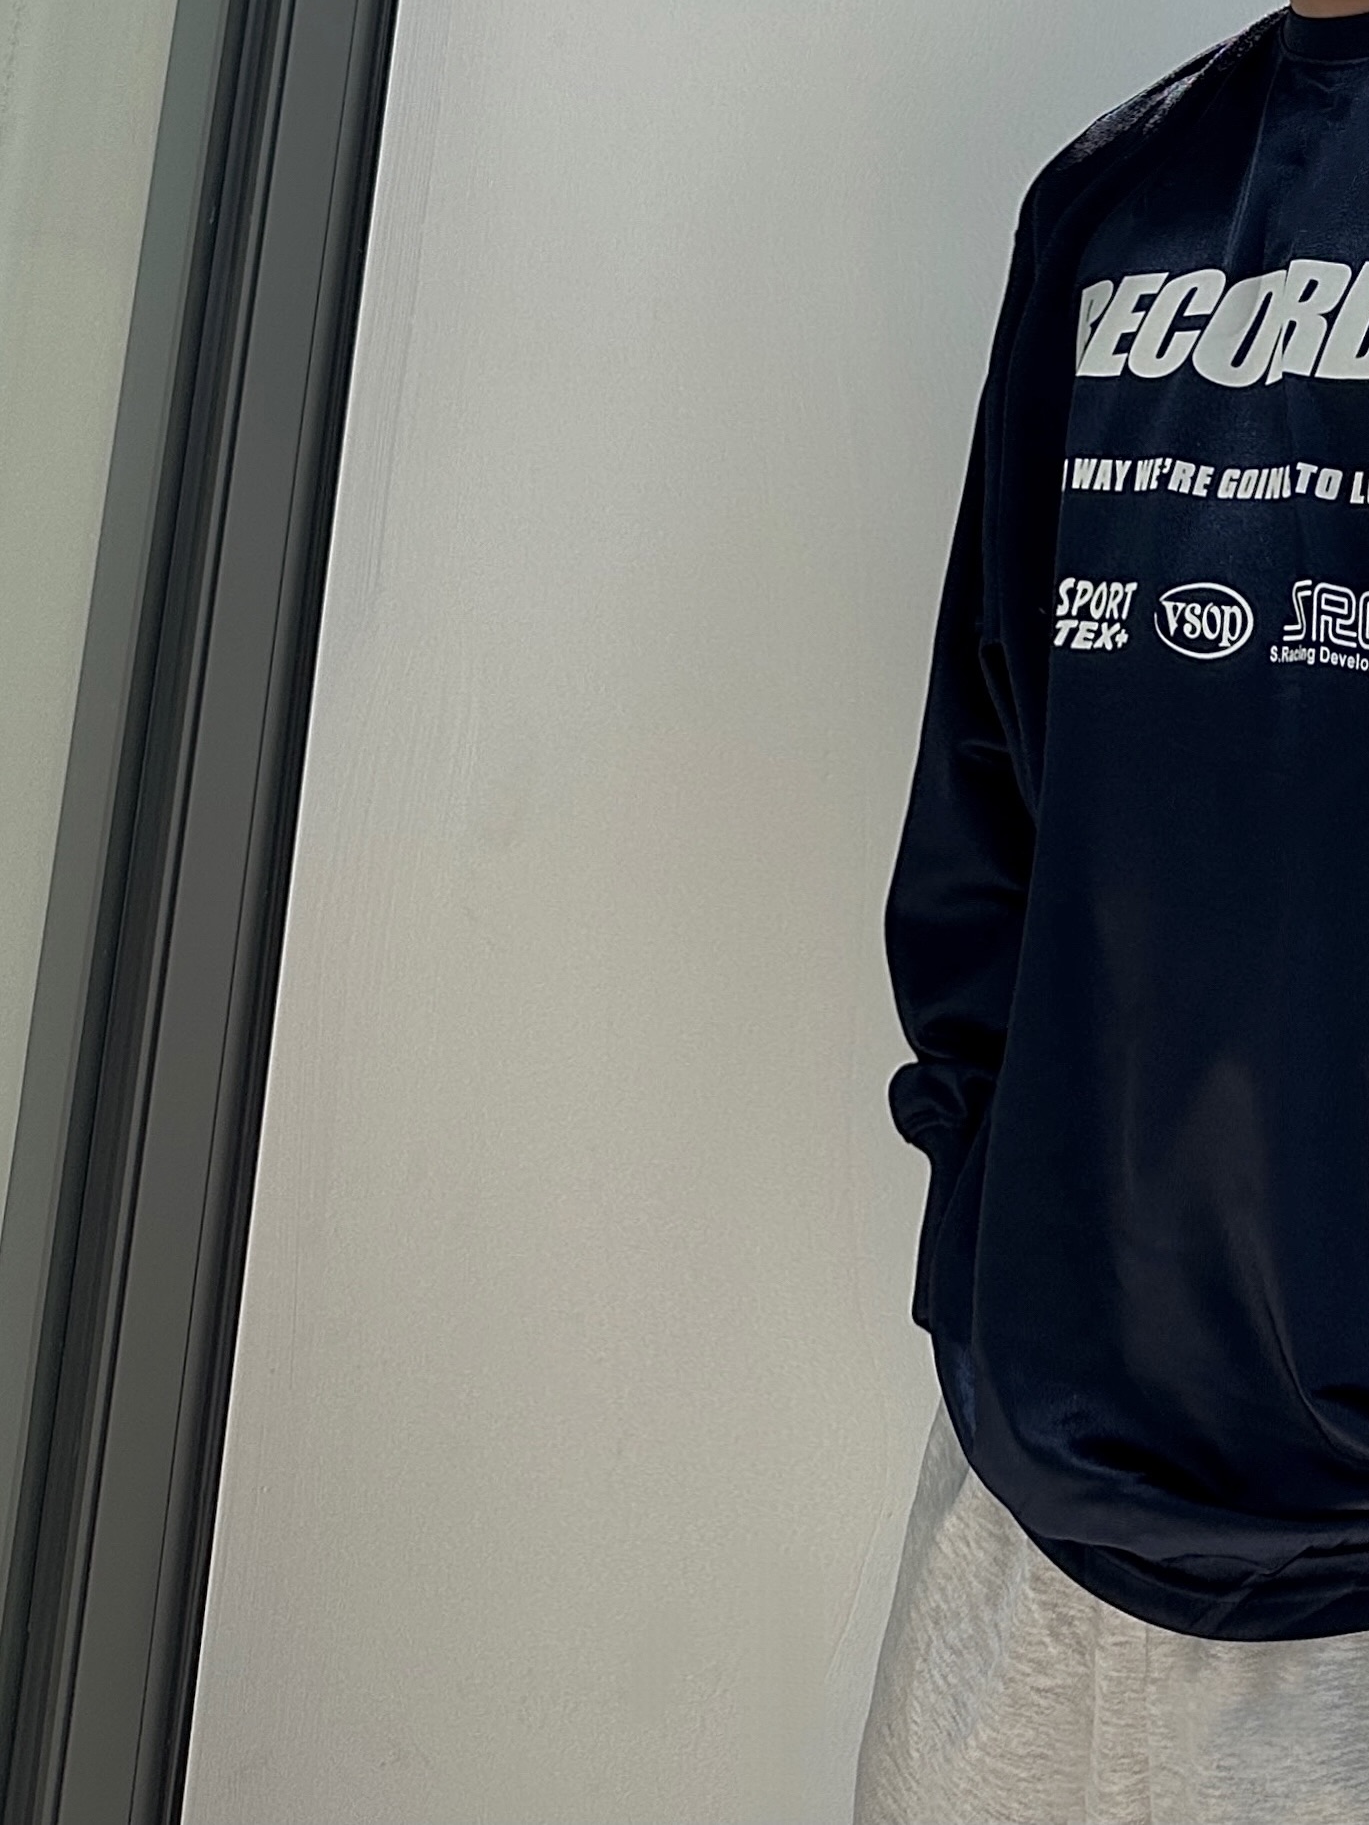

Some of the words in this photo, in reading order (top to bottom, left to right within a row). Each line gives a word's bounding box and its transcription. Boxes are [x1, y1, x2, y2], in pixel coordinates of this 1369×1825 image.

[1072, 457, 1132, 492] WAY
[1295, 462, 1343, 500] TO
[1056, 577, 1138, 620] SPORT
